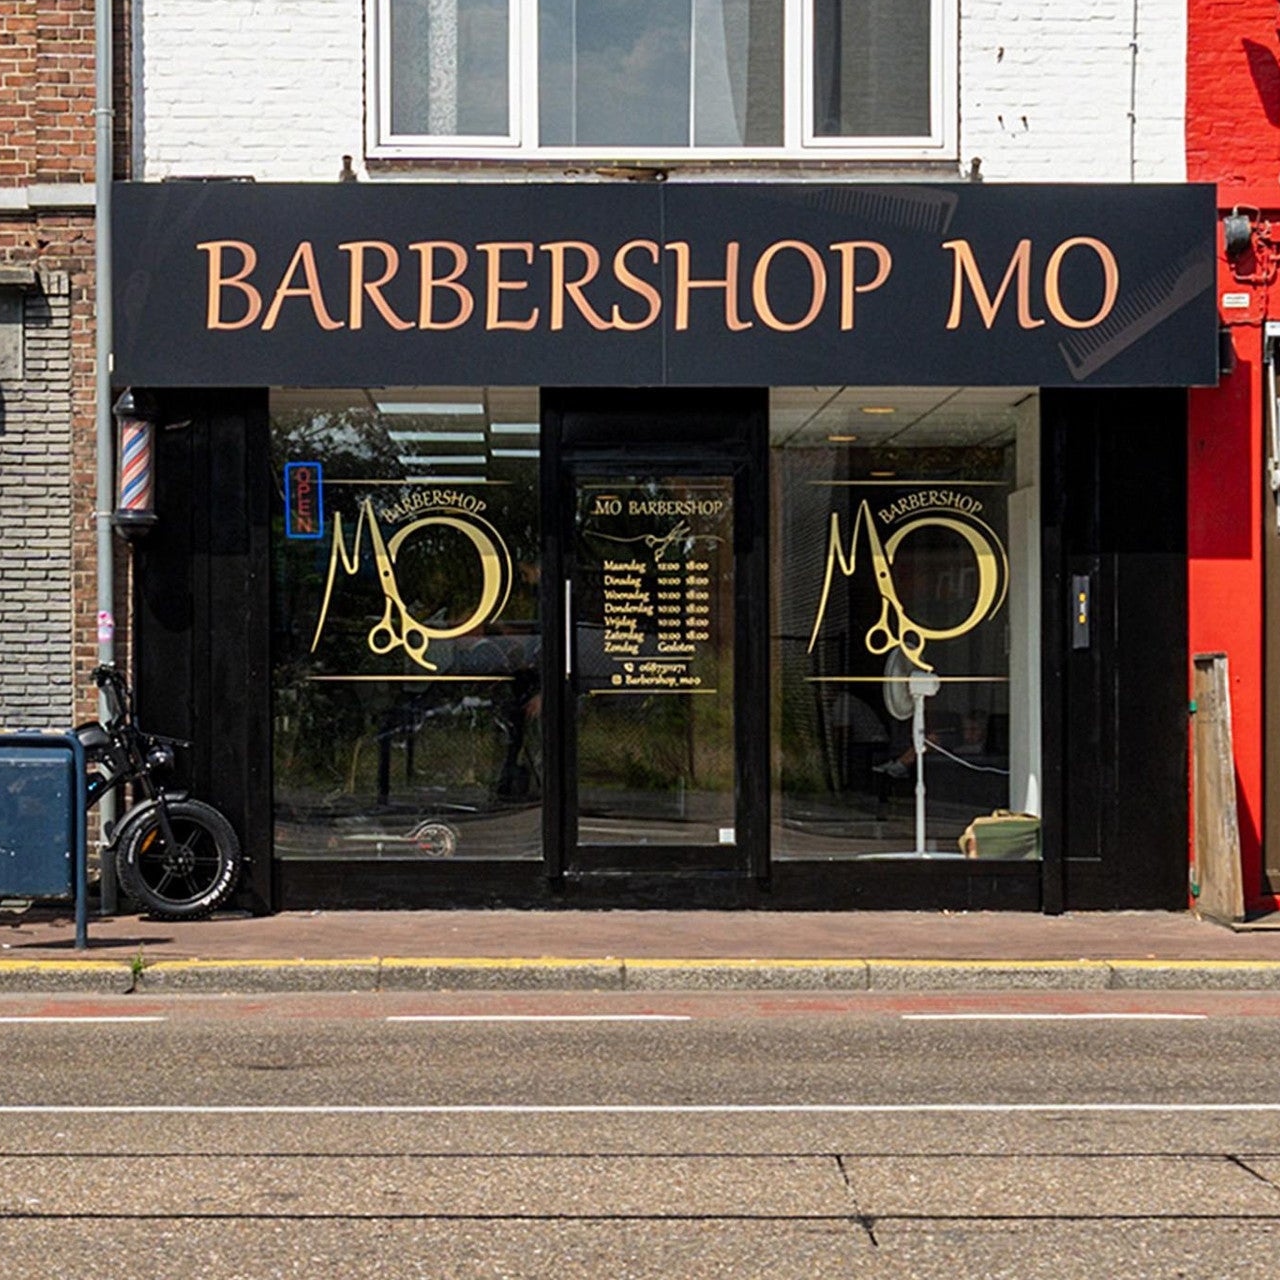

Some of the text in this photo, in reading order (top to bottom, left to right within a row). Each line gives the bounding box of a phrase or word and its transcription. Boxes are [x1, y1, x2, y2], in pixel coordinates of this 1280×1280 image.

[195, 236, 1121, 333] BARBERSHOP MO
[296, 466, 312, 533] OPEN
[381, 488, 488, 524] BARBERSHOP
[877, 489, 984, 524] BARBERSHOP
[594, 499, 723, 516] MO BARBERSHOP
[604, 575, 642, 588] Dinsdag
[603, 589, 650, 603] Woensdag
[604, 603, 654, 616] Donderdag
[604, 616, 637, 629] Vrijdag
[604, 629, 645, 643] Zaterdag
[604, 642, 696, 655] Zondag Gesloten
